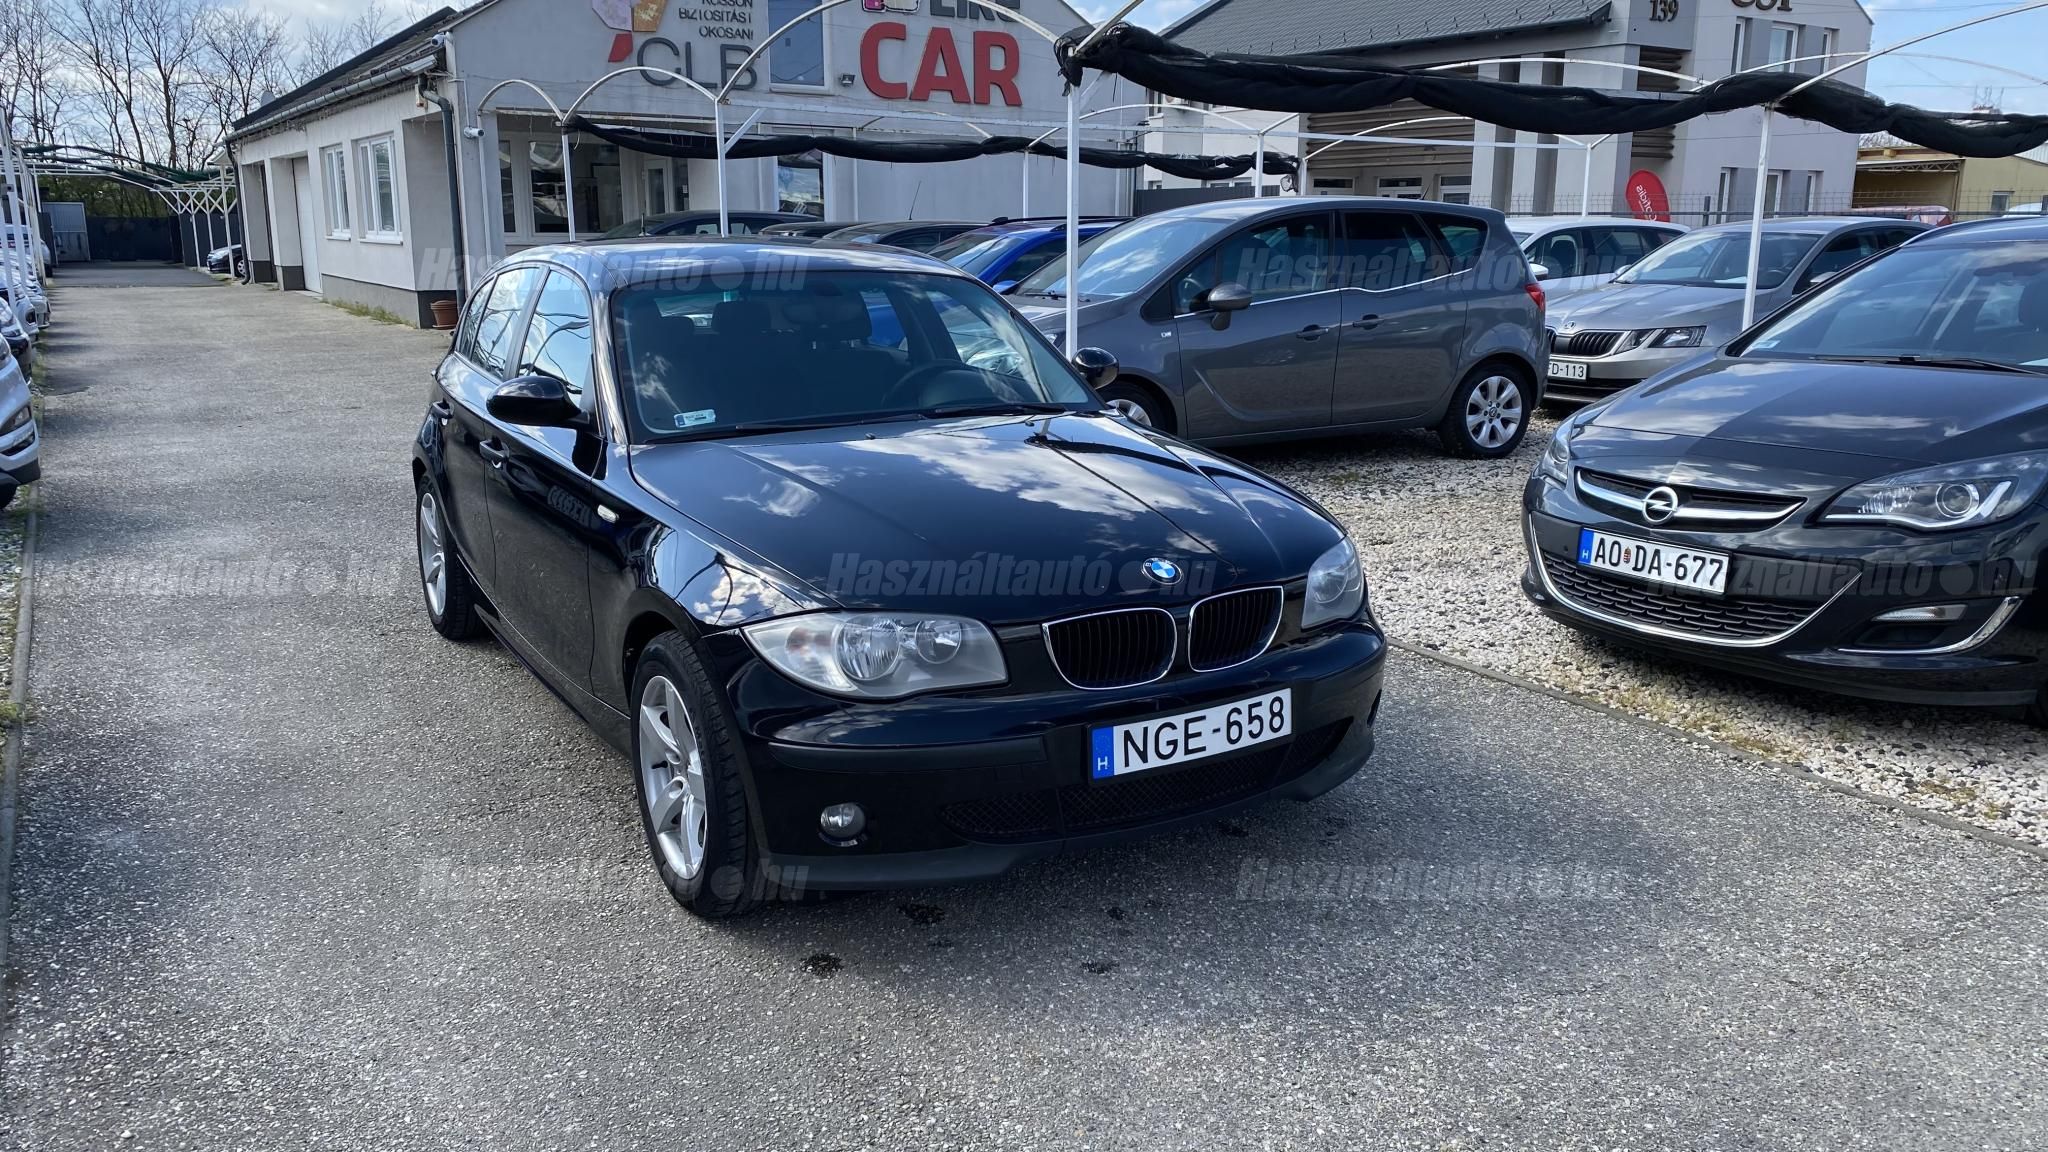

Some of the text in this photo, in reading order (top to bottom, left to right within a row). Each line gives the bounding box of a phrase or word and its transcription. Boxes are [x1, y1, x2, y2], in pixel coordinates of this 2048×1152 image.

[1649, 0, 1679, 22] 139
[637, 36, 757, 90] CLB
[860, 22, 1022, 106] CAR
[1550, 362, 1585, 378] D-113
[1632, 545, 1724, 586] DA-677
[1123, 695, 1285, 768] NGE-658
[1097, 756, 1108, 771] H
